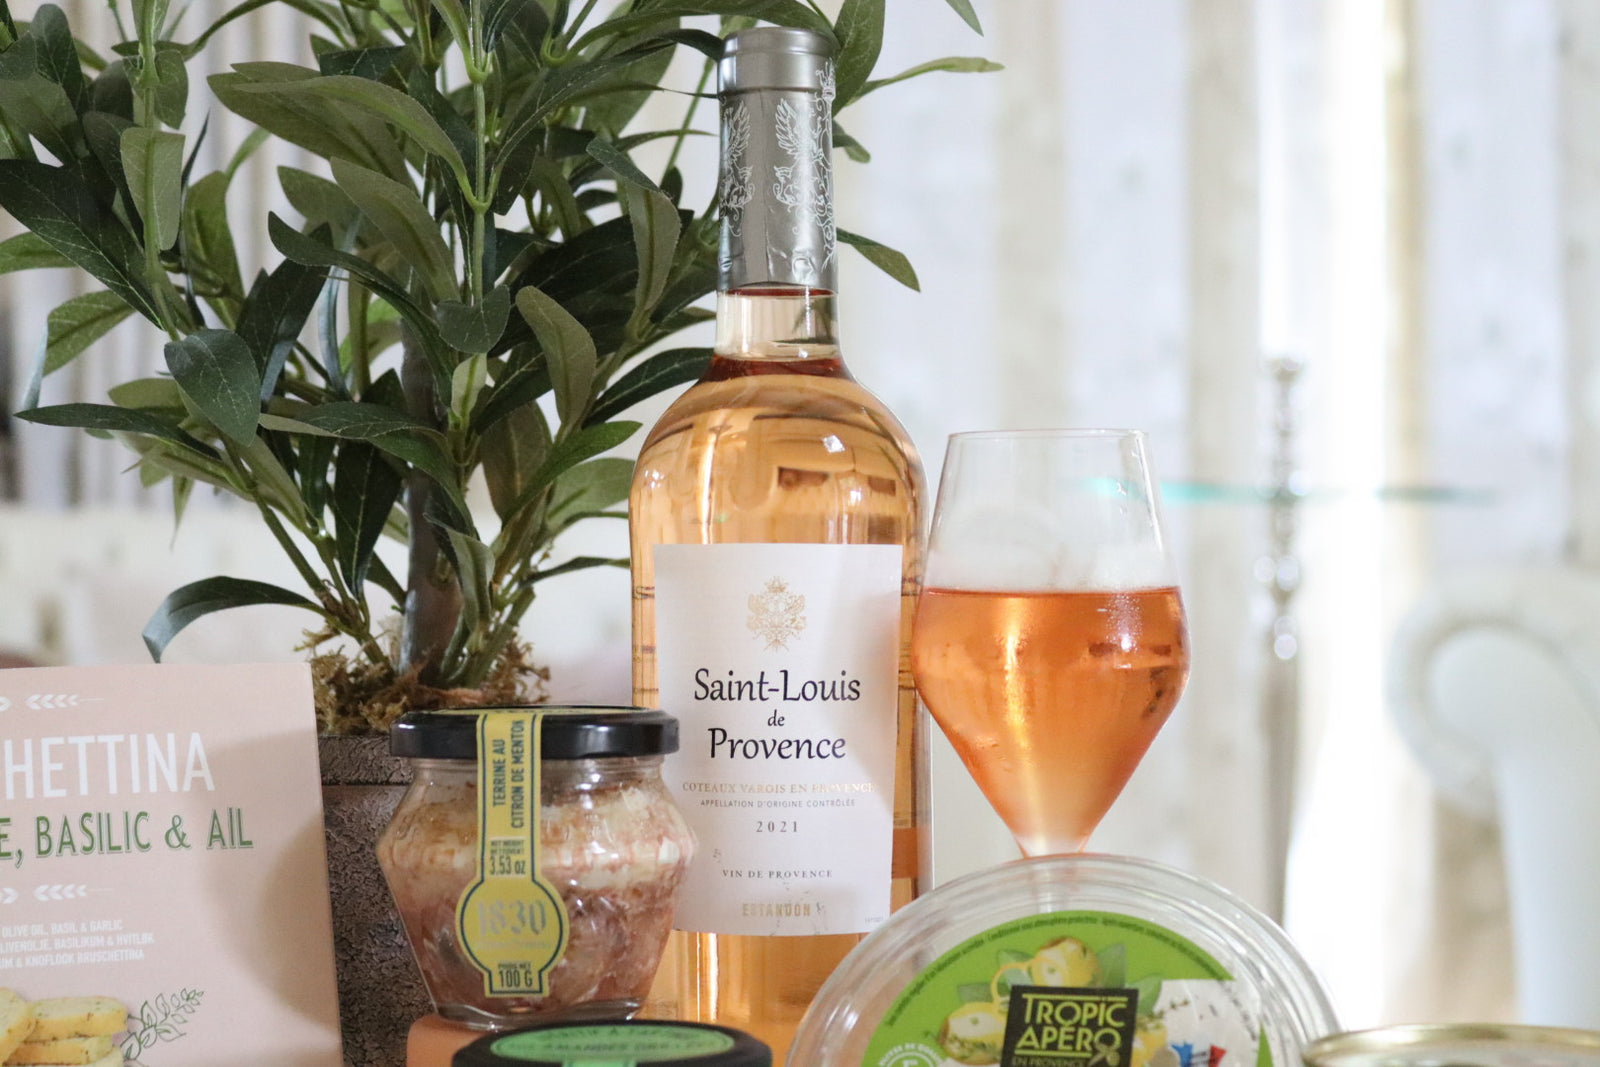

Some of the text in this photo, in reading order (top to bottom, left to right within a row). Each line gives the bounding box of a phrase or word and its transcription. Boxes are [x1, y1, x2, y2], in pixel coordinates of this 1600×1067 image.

[694, 668, 861, 701] Saint-Louis
[767, 709, 785, 726] de
[708, 728, 847, 759] Provence
[4, 733, 215, 799] HETTINA
[493, 739, 506, 807] TERRINE AU
[511, 720, 524, 829] CITRON DE MENTON
[682, 782, 736, 792] COTEAUX
[741, 783, 786, 793] VAROIS
[790, 783, 807, 793] EN
[701, 799, 754, 808] APPELLATION
[757, 799, 803, 808] D'ORIGINE
[36, 812, 151, 858] BASILIC
[164, 815, 191, 850] &
[206, 807, 253, 850] AIL
[756, 821, 799, 833] 2021
[723, 869, 832, 878] VIN DE PROVENCE
[476, 899, 547, 936] 1830
[499, 970, 533, 987] 100 G
[1022, 993, 1128, 1028] TROPIC
